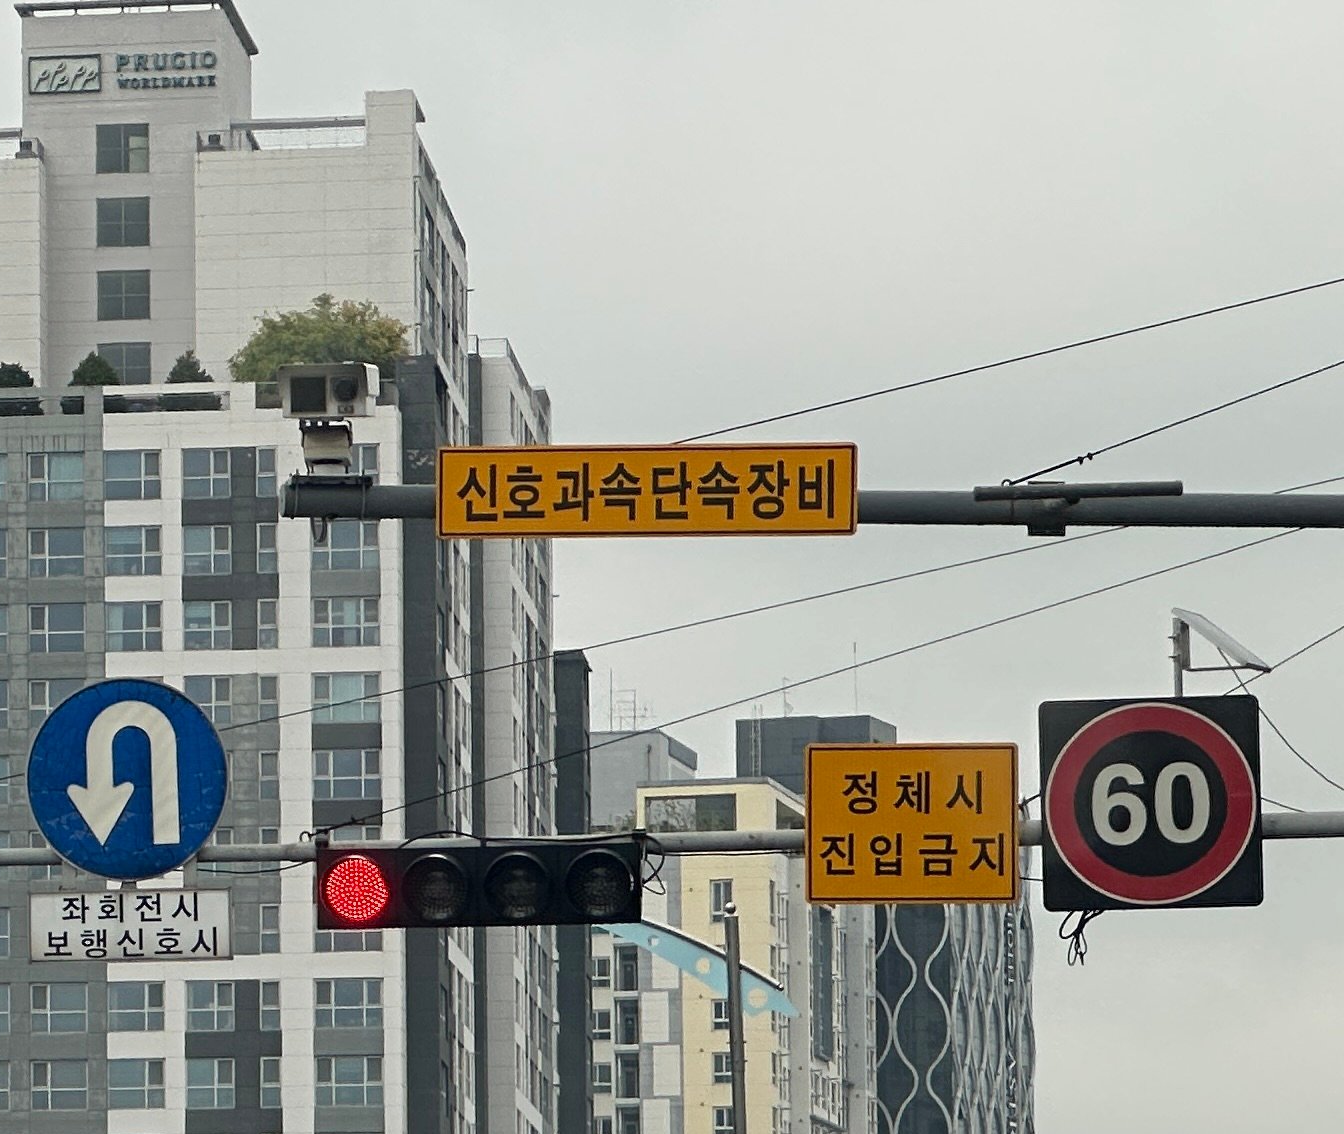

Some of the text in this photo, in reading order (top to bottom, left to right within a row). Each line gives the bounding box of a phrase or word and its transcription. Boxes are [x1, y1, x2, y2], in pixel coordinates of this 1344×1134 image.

[116, 51, 217, 72] PRUGIO
[117, 74, 216, 89] WORLDMARK
[456, 463, 839, 524] 신호과속단속장비
[842, 770, 983, 814] 정체시
[1091, 760, 1211, 845] 60
[820, 833, 1004, 876] 진입금지
[62, 892, 199, 923] 좌회전시
[44, 926, 217, 958] 보행신호시
